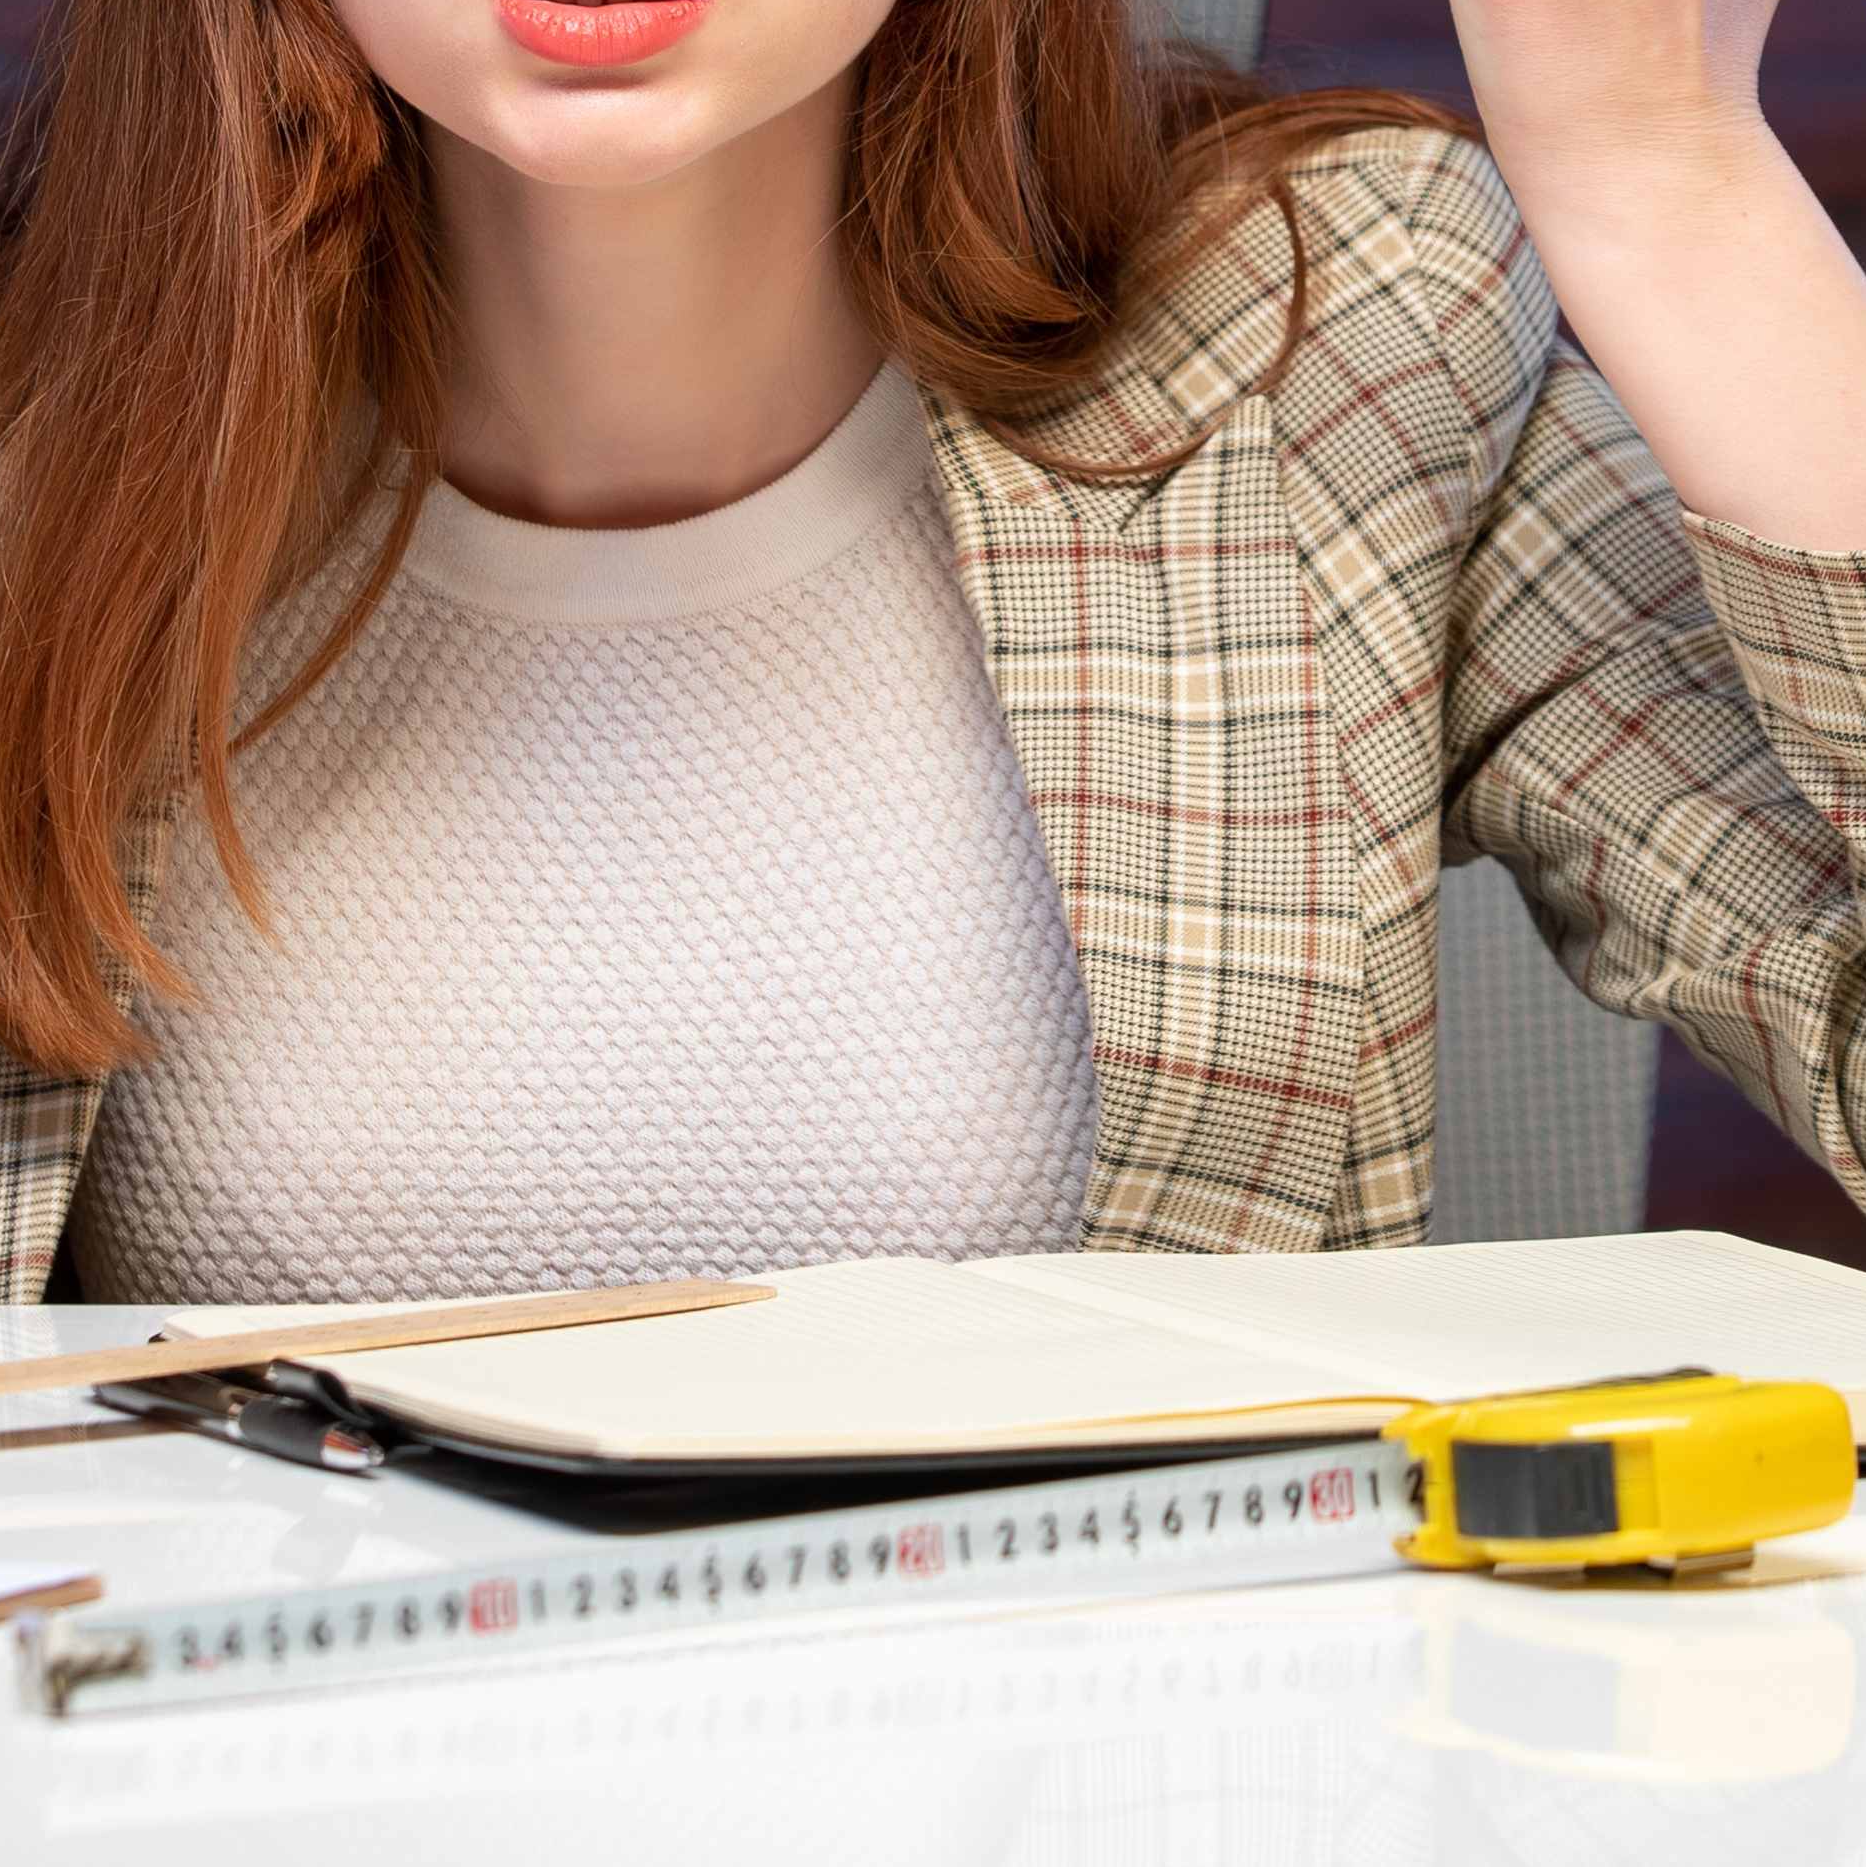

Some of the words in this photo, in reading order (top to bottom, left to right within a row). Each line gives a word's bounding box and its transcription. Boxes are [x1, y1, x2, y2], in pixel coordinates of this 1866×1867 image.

[306, 1610, 334, 1654] 6
[657, 1561, 681, 1600] 4
[742, 1551, 767, 1595] 6
[787, 1544, 807, 1589] 7
[828, 1539, 851, 1584] 8
[868, 1534, 891, 1576] 9
[957, 1522, 971, 1566] 1
[994, 1518, 1019, 1561] 2
[1037, 1511, 1059, 1556] 3
[1079, 1506, 1100, 1549] 4
[1121, 1497, 1142, 1547] 5
[1162, 1495, 1184, 1538] 6
[1204, 1489, 1223, 1532] 7
[1243, 1482, 1264, 1526] 8
[1283, 1477, 1303, 1520] 9
[1310, 1470, 1355, 1522] 30
[1367, 1468, 1380, 1509] 1
